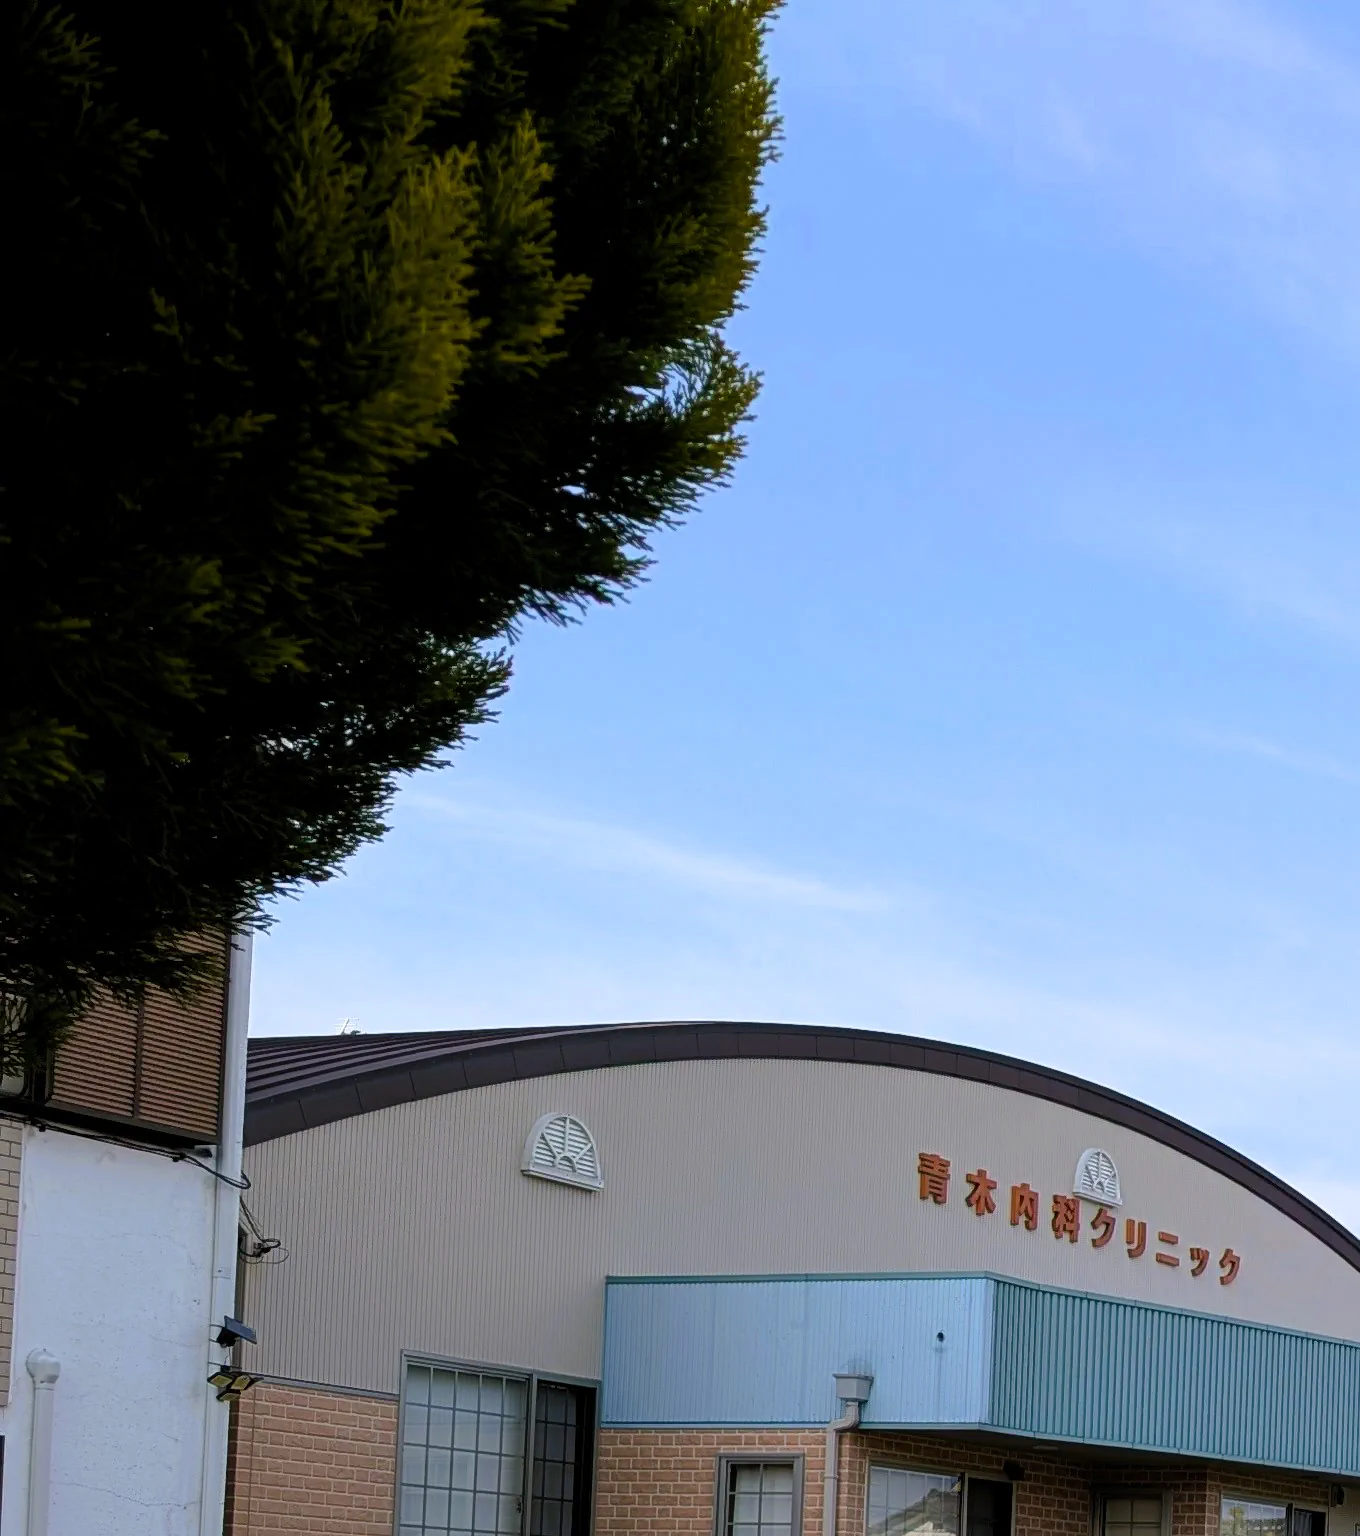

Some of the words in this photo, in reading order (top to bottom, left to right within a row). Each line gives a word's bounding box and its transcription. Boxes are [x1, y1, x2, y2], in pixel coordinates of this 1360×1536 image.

[917, 1152, 1241, 1286] 青木内科クリニック
